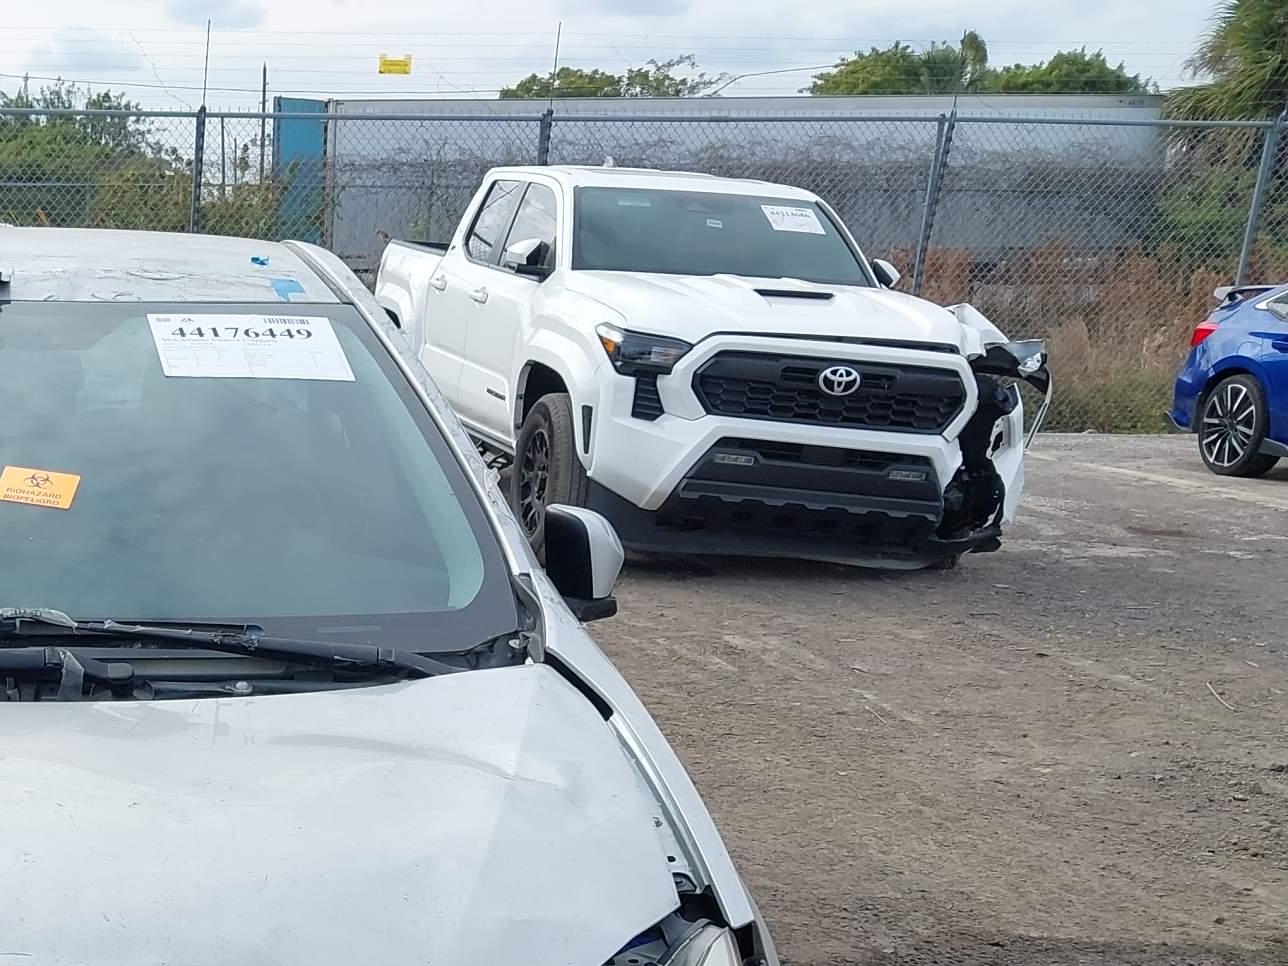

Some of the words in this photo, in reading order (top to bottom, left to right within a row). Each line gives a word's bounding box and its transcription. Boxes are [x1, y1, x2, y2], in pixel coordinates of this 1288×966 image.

[171, 327, 314, 340] 44176449
[3, 493, 60, 505] BIOPELIGRO
[6, 487, 62, 499] BIOHAZARD
